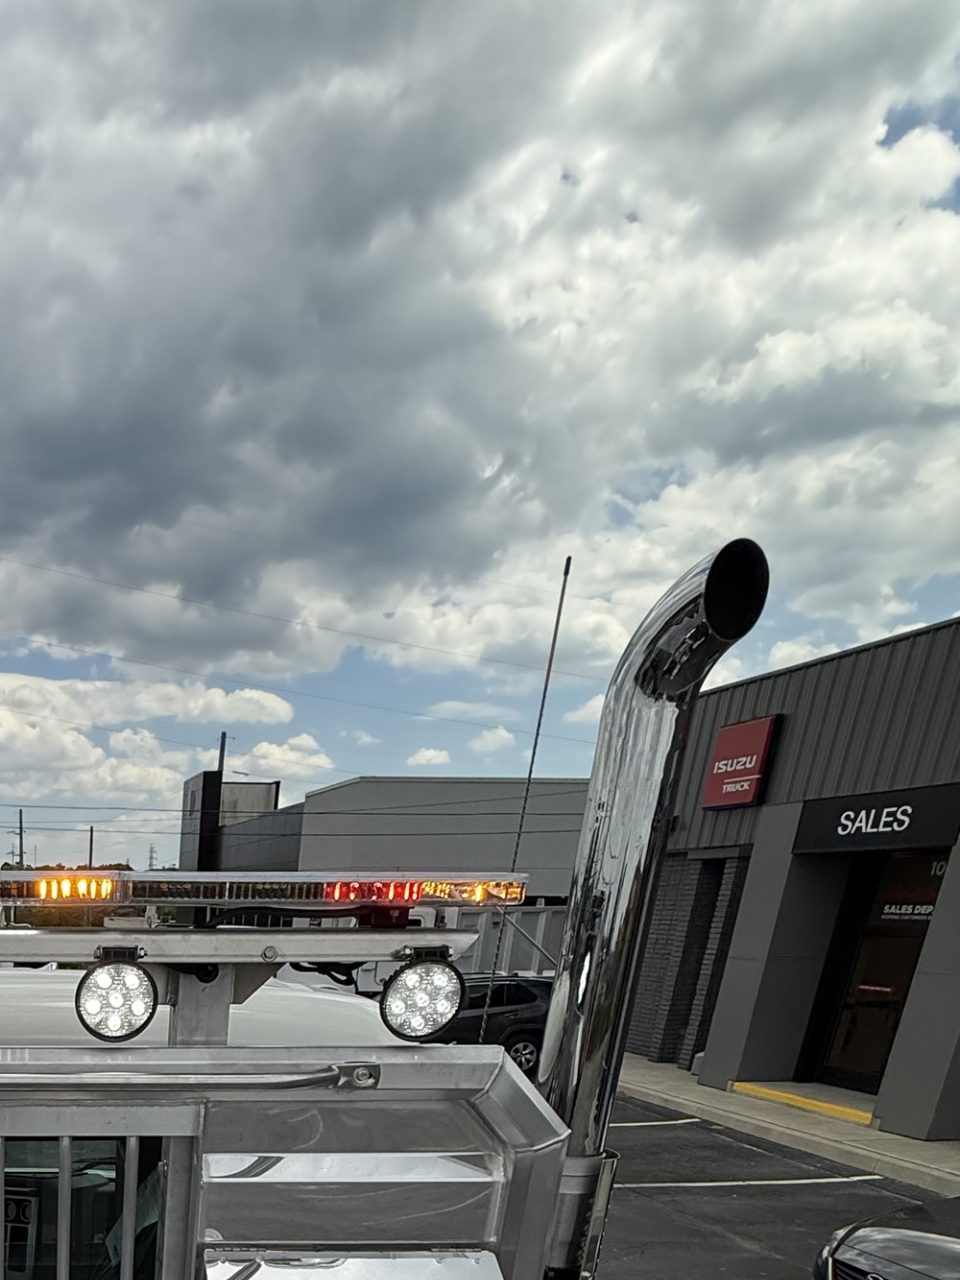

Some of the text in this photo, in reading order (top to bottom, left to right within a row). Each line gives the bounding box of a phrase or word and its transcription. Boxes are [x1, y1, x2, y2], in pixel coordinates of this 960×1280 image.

[713, 754, 757, 774] ISUZU
[722, 781, 751, 794] TRUCK
[837, 805, 913, 836] SALES
[883, 905, 913, 914] SALES
